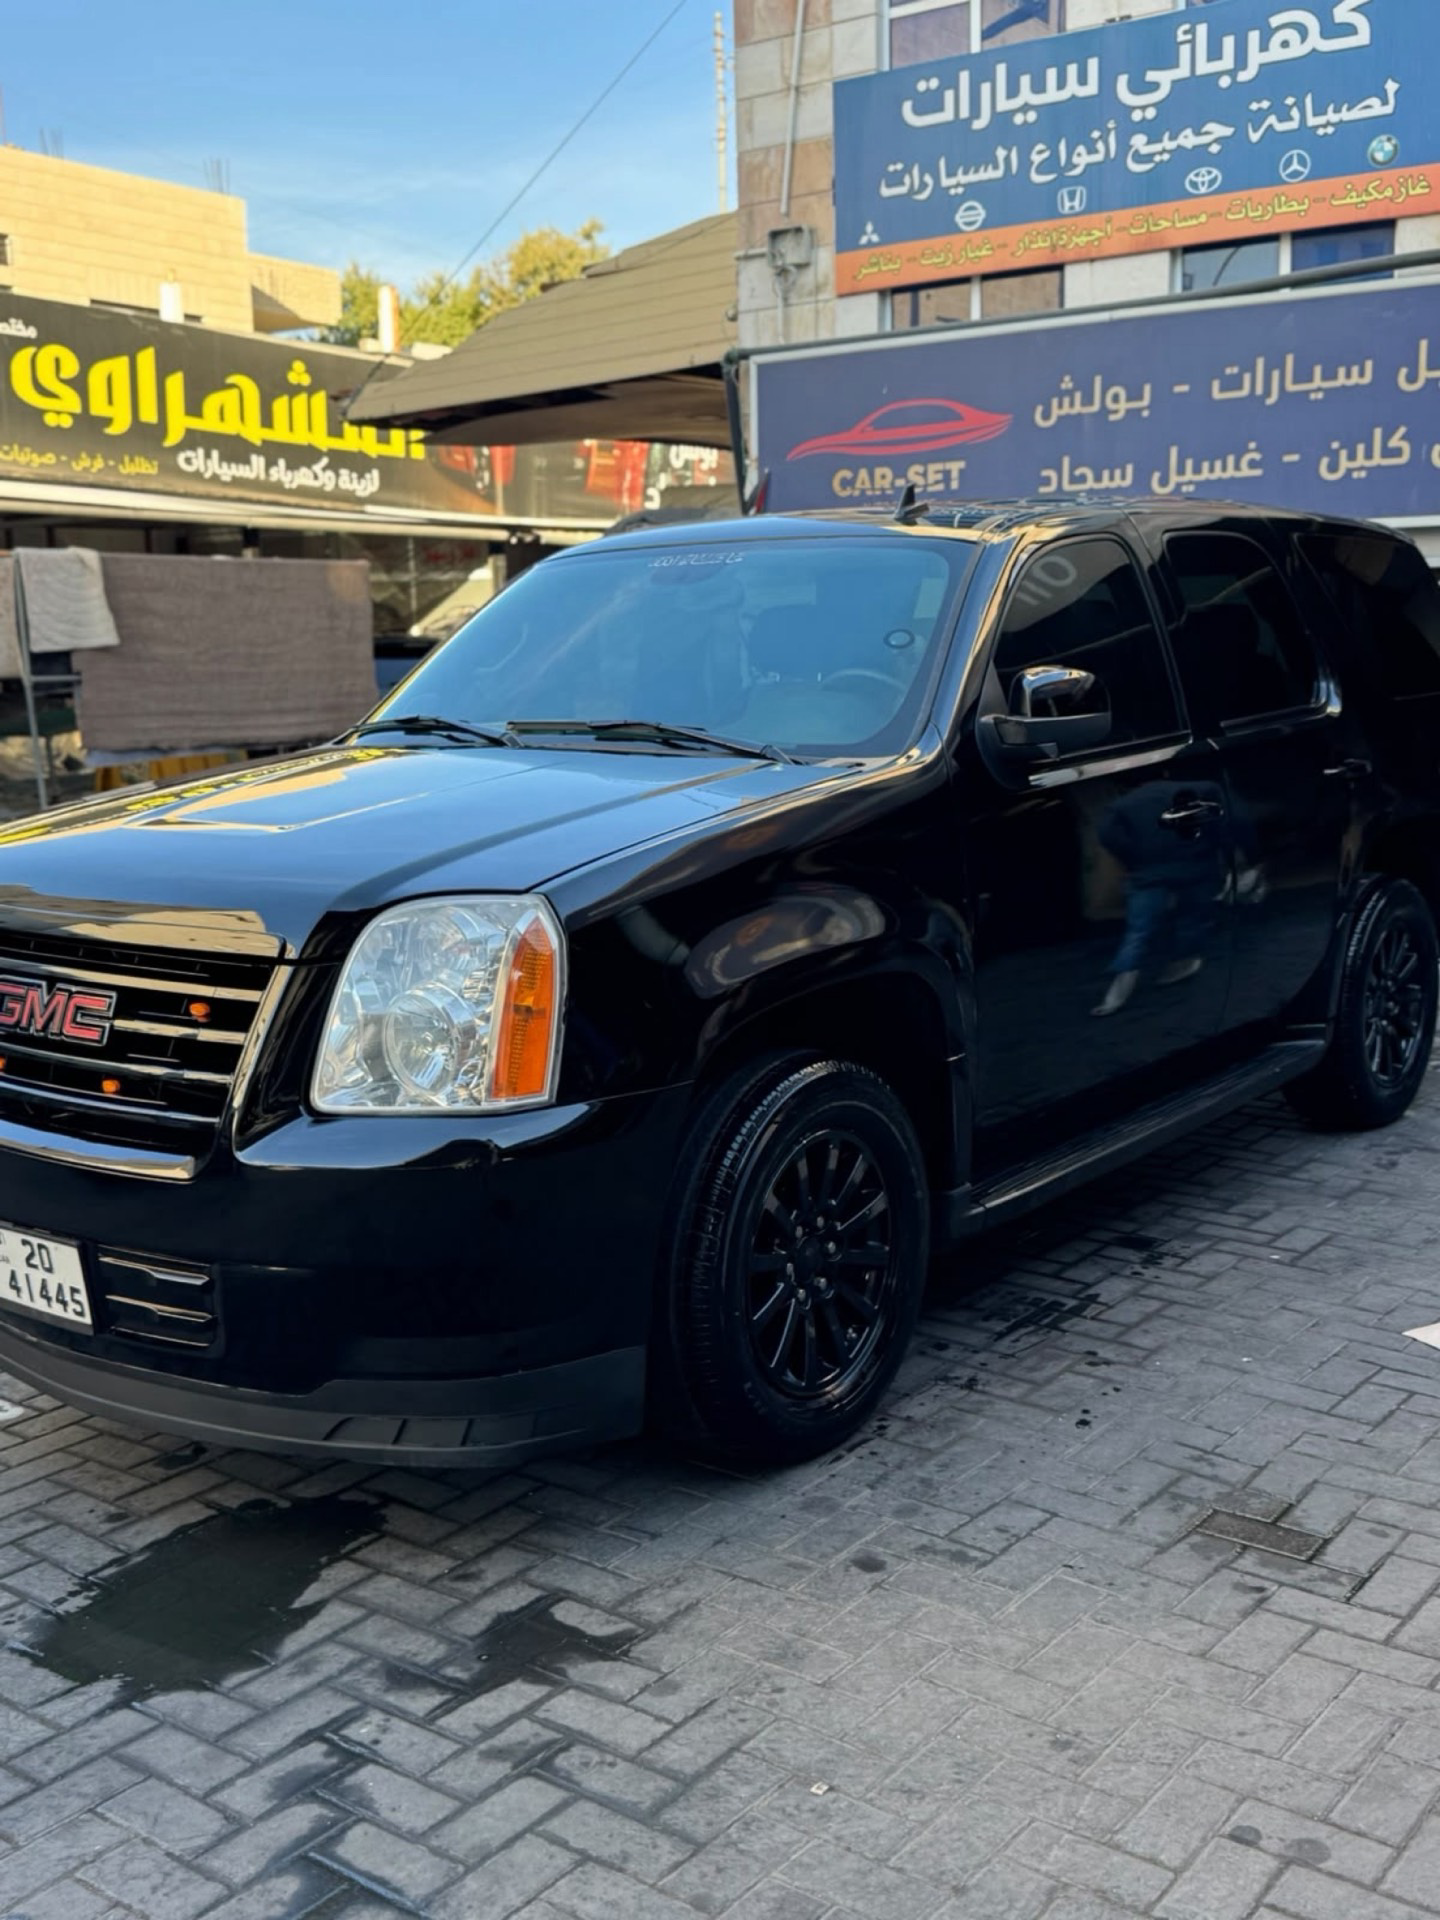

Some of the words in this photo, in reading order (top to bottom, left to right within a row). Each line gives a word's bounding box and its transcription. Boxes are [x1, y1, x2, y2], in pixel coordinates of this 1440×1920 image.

[1116, 0, 1372, 122] كهربائي
[902, 56, 1099, 130] سيارات
[1248, 78, 1400, 143] لصيانة
[879, 145, 1018, 200] السيارات
[1029, 119, 1118, 184] أنواع
[1126, 121, 1235, 173] جميع
[1225, 194, 1310, 222] بطاريات
[1034, 374, 1152, 428] بولش
[1211, 353, 1373, 406] سيارات
[177, 447, 266, 482] السيارات
[832, 460, 966, 497] CAR-SET
[1038, 455, 1134, 497] سجاد
[1151, 441, 1264, 494] غسيل
[1318, 425, 1411, 481] كلين
[0, 975, 117, 1046] GMC
[21, 1238, 54, 1274] 20
[9, 1269, 85, 1318] 41445
